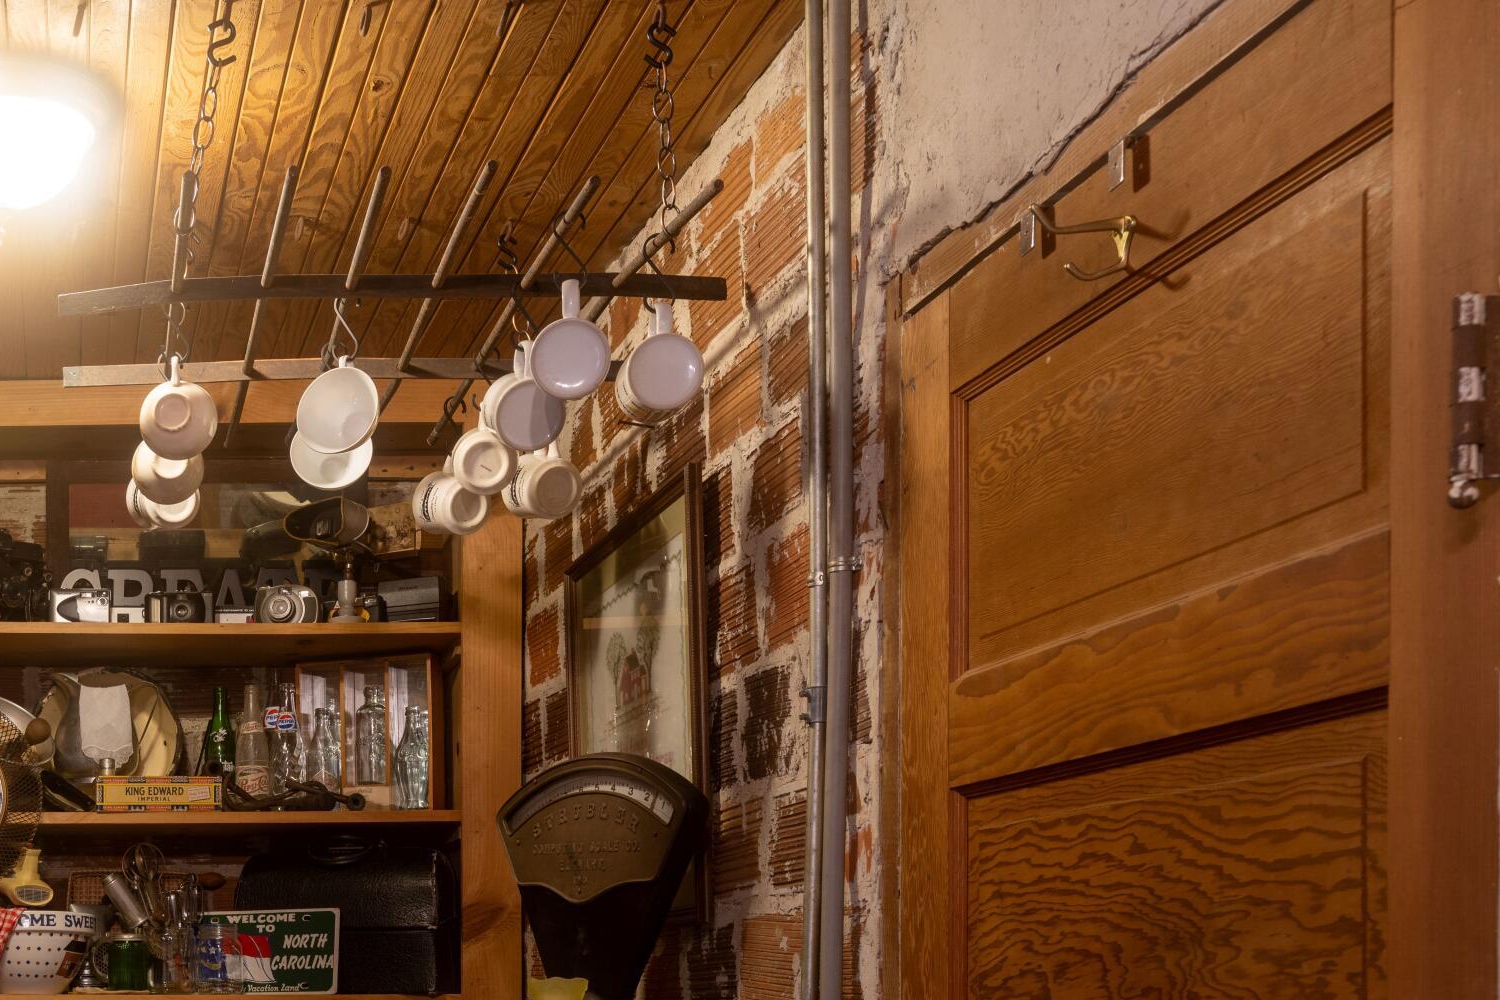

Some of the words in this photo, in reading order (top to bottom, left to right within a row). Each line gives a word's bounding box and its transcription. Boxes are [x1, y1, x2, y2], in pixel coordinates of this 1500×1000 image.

[125, 786, 145, 796] KING
[148, 786, 184, 796] EDWARD
[18, 913, 57, 927] OME
[226, 913, 296, 924] WELCOME
[256, 924, 276, 933] TO
[282, 933, 328, 949] NORTH
[271, 954, 334, 971] CAROLINA
[247, 983, 279, 992] Vacation
[281, 982, 300, 992] Land
